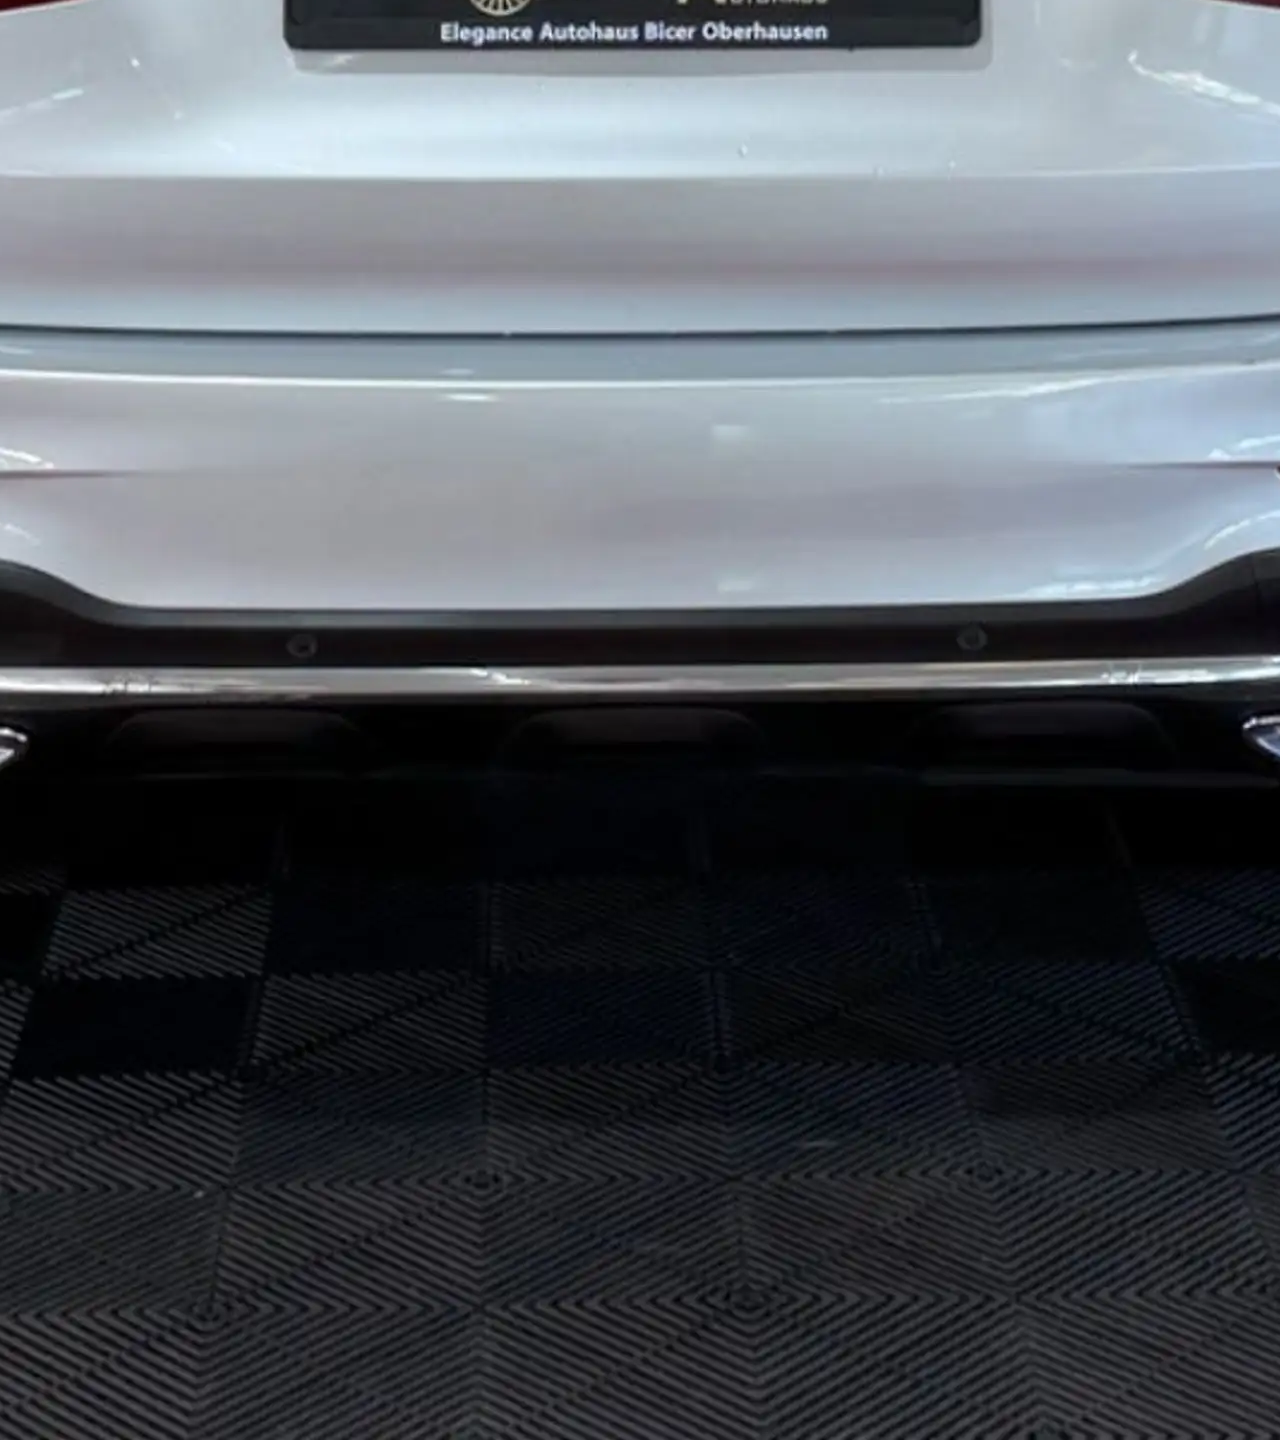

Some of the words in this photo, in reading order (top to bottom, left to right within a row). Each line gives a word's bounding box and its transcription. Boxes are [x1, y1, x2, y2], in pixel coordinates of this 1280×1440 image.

[440, 21, 533, 47] Elegance
[539, 19, 639, 42] Autohaus
[644, 19, 696, 42] Bicer
[701, 19, 829, 42] Oberhausen
